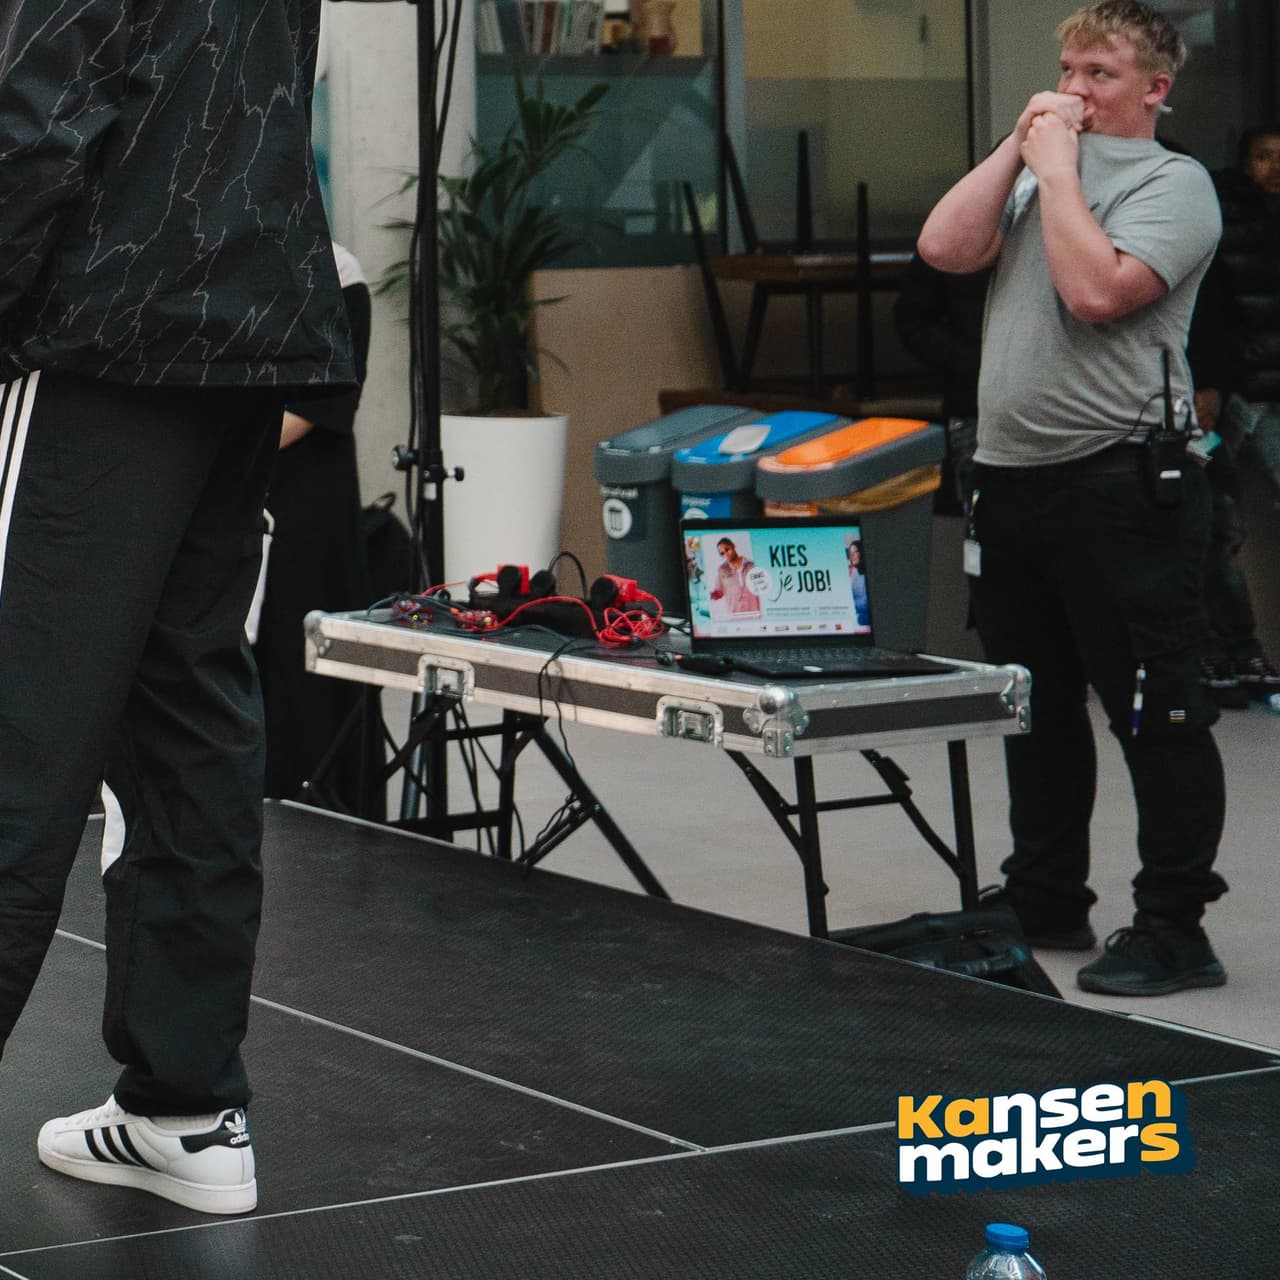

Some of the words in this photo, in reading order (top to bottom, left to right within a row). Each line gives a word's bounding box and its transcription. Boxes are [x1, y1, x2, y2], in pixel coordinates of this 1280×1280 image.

[769, 544, 809, 568] KIES
[767, 570, 794, 602] je
[797, 569, 832, 593] JOB!
